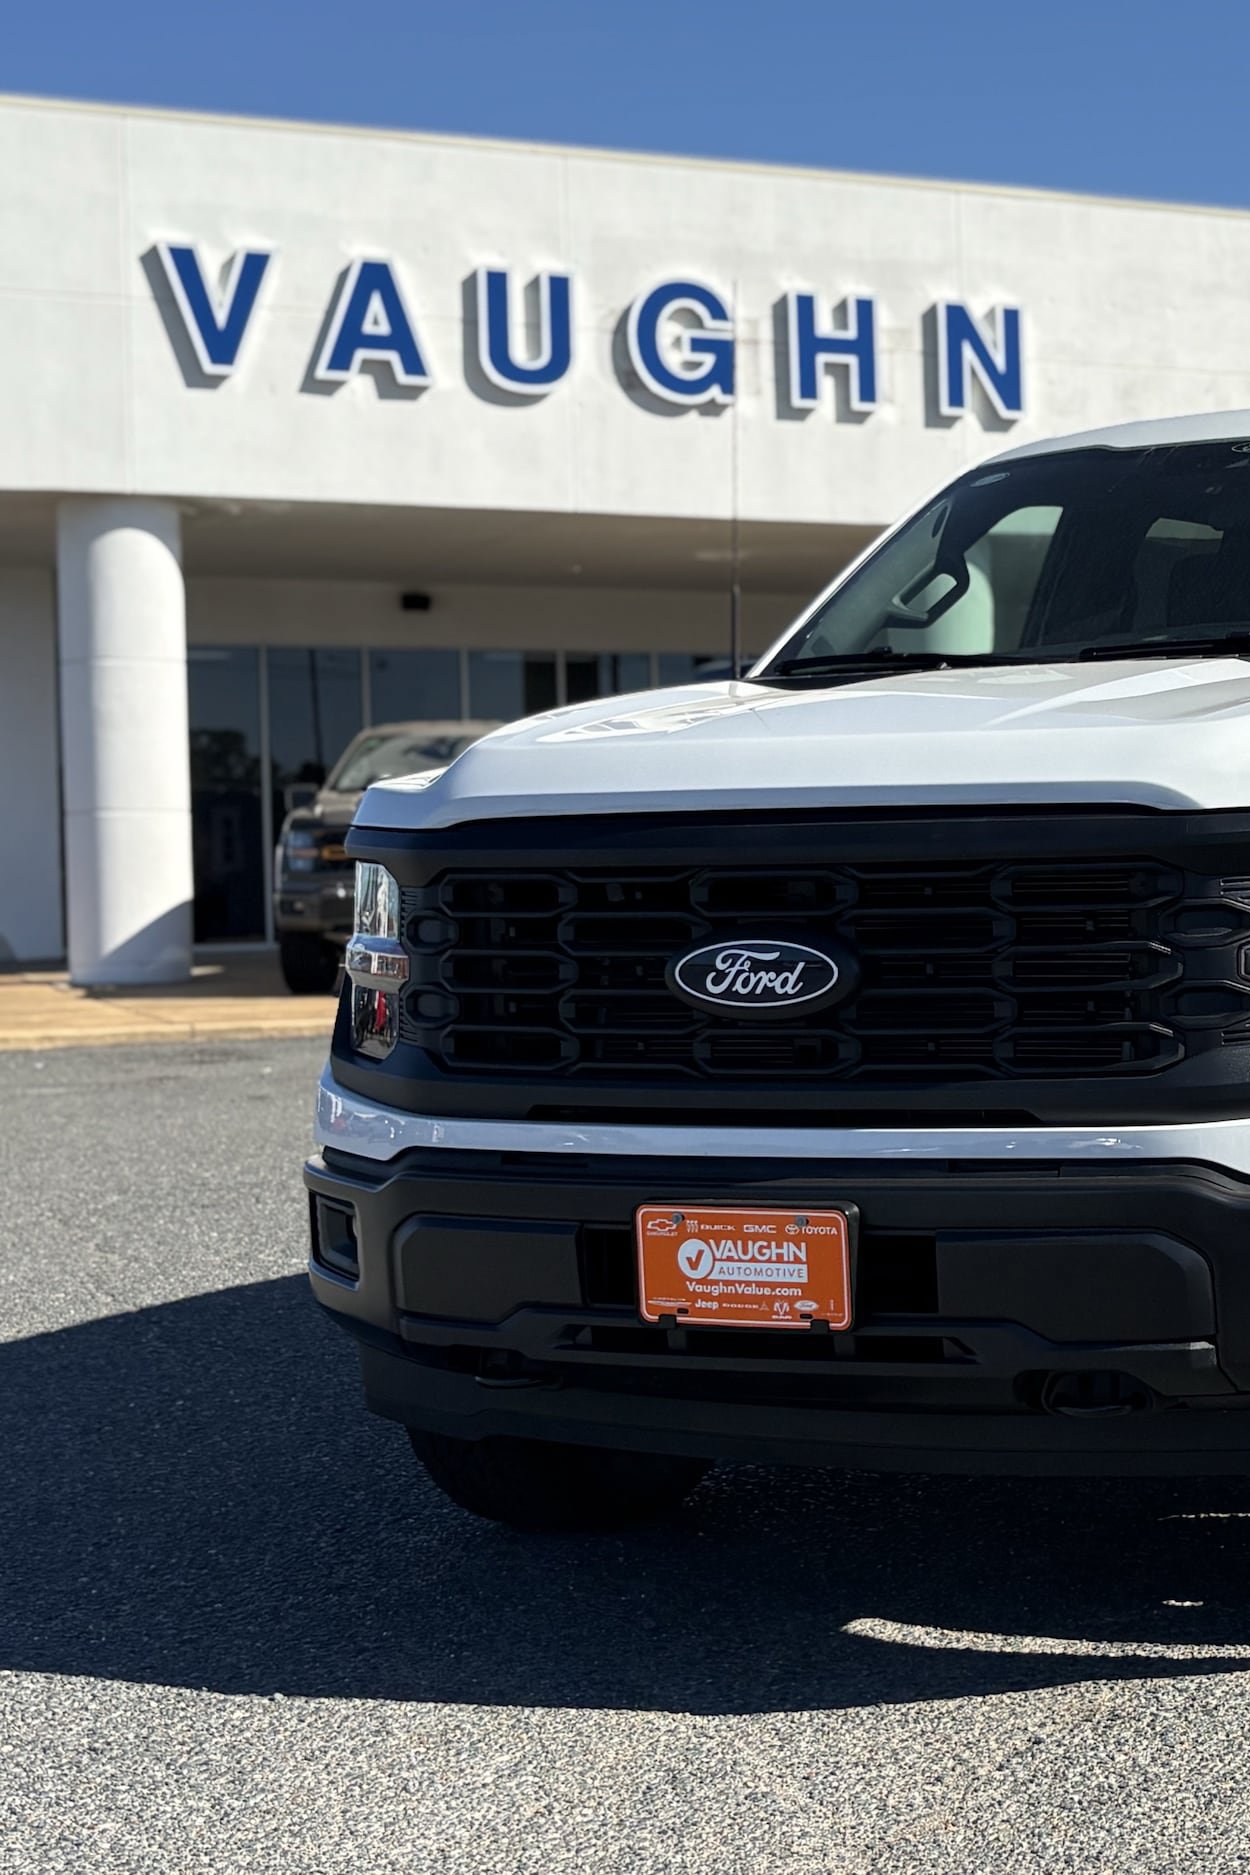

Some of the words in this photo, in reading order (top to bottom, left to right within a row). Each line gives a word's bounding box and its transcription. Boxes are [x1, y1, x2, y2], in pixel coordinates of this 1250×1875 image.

[154, 242, 1025, 421] VAUGHN
[705, 948, 806, 995] Ford
[700, 1223, 737, 1232] BUICK
[743, 1223, 777, 1234] GMC
[801, 1225, 838, 1236] TOYOTA
[709, 1239, 807, 1263] VAUGHN
[717, 1265, 805, 1279] AUTOMOTIVE
[686, 1280, 802, 1297] VaughnValue.com
[694, 1299, 720, 1311] Jeep
